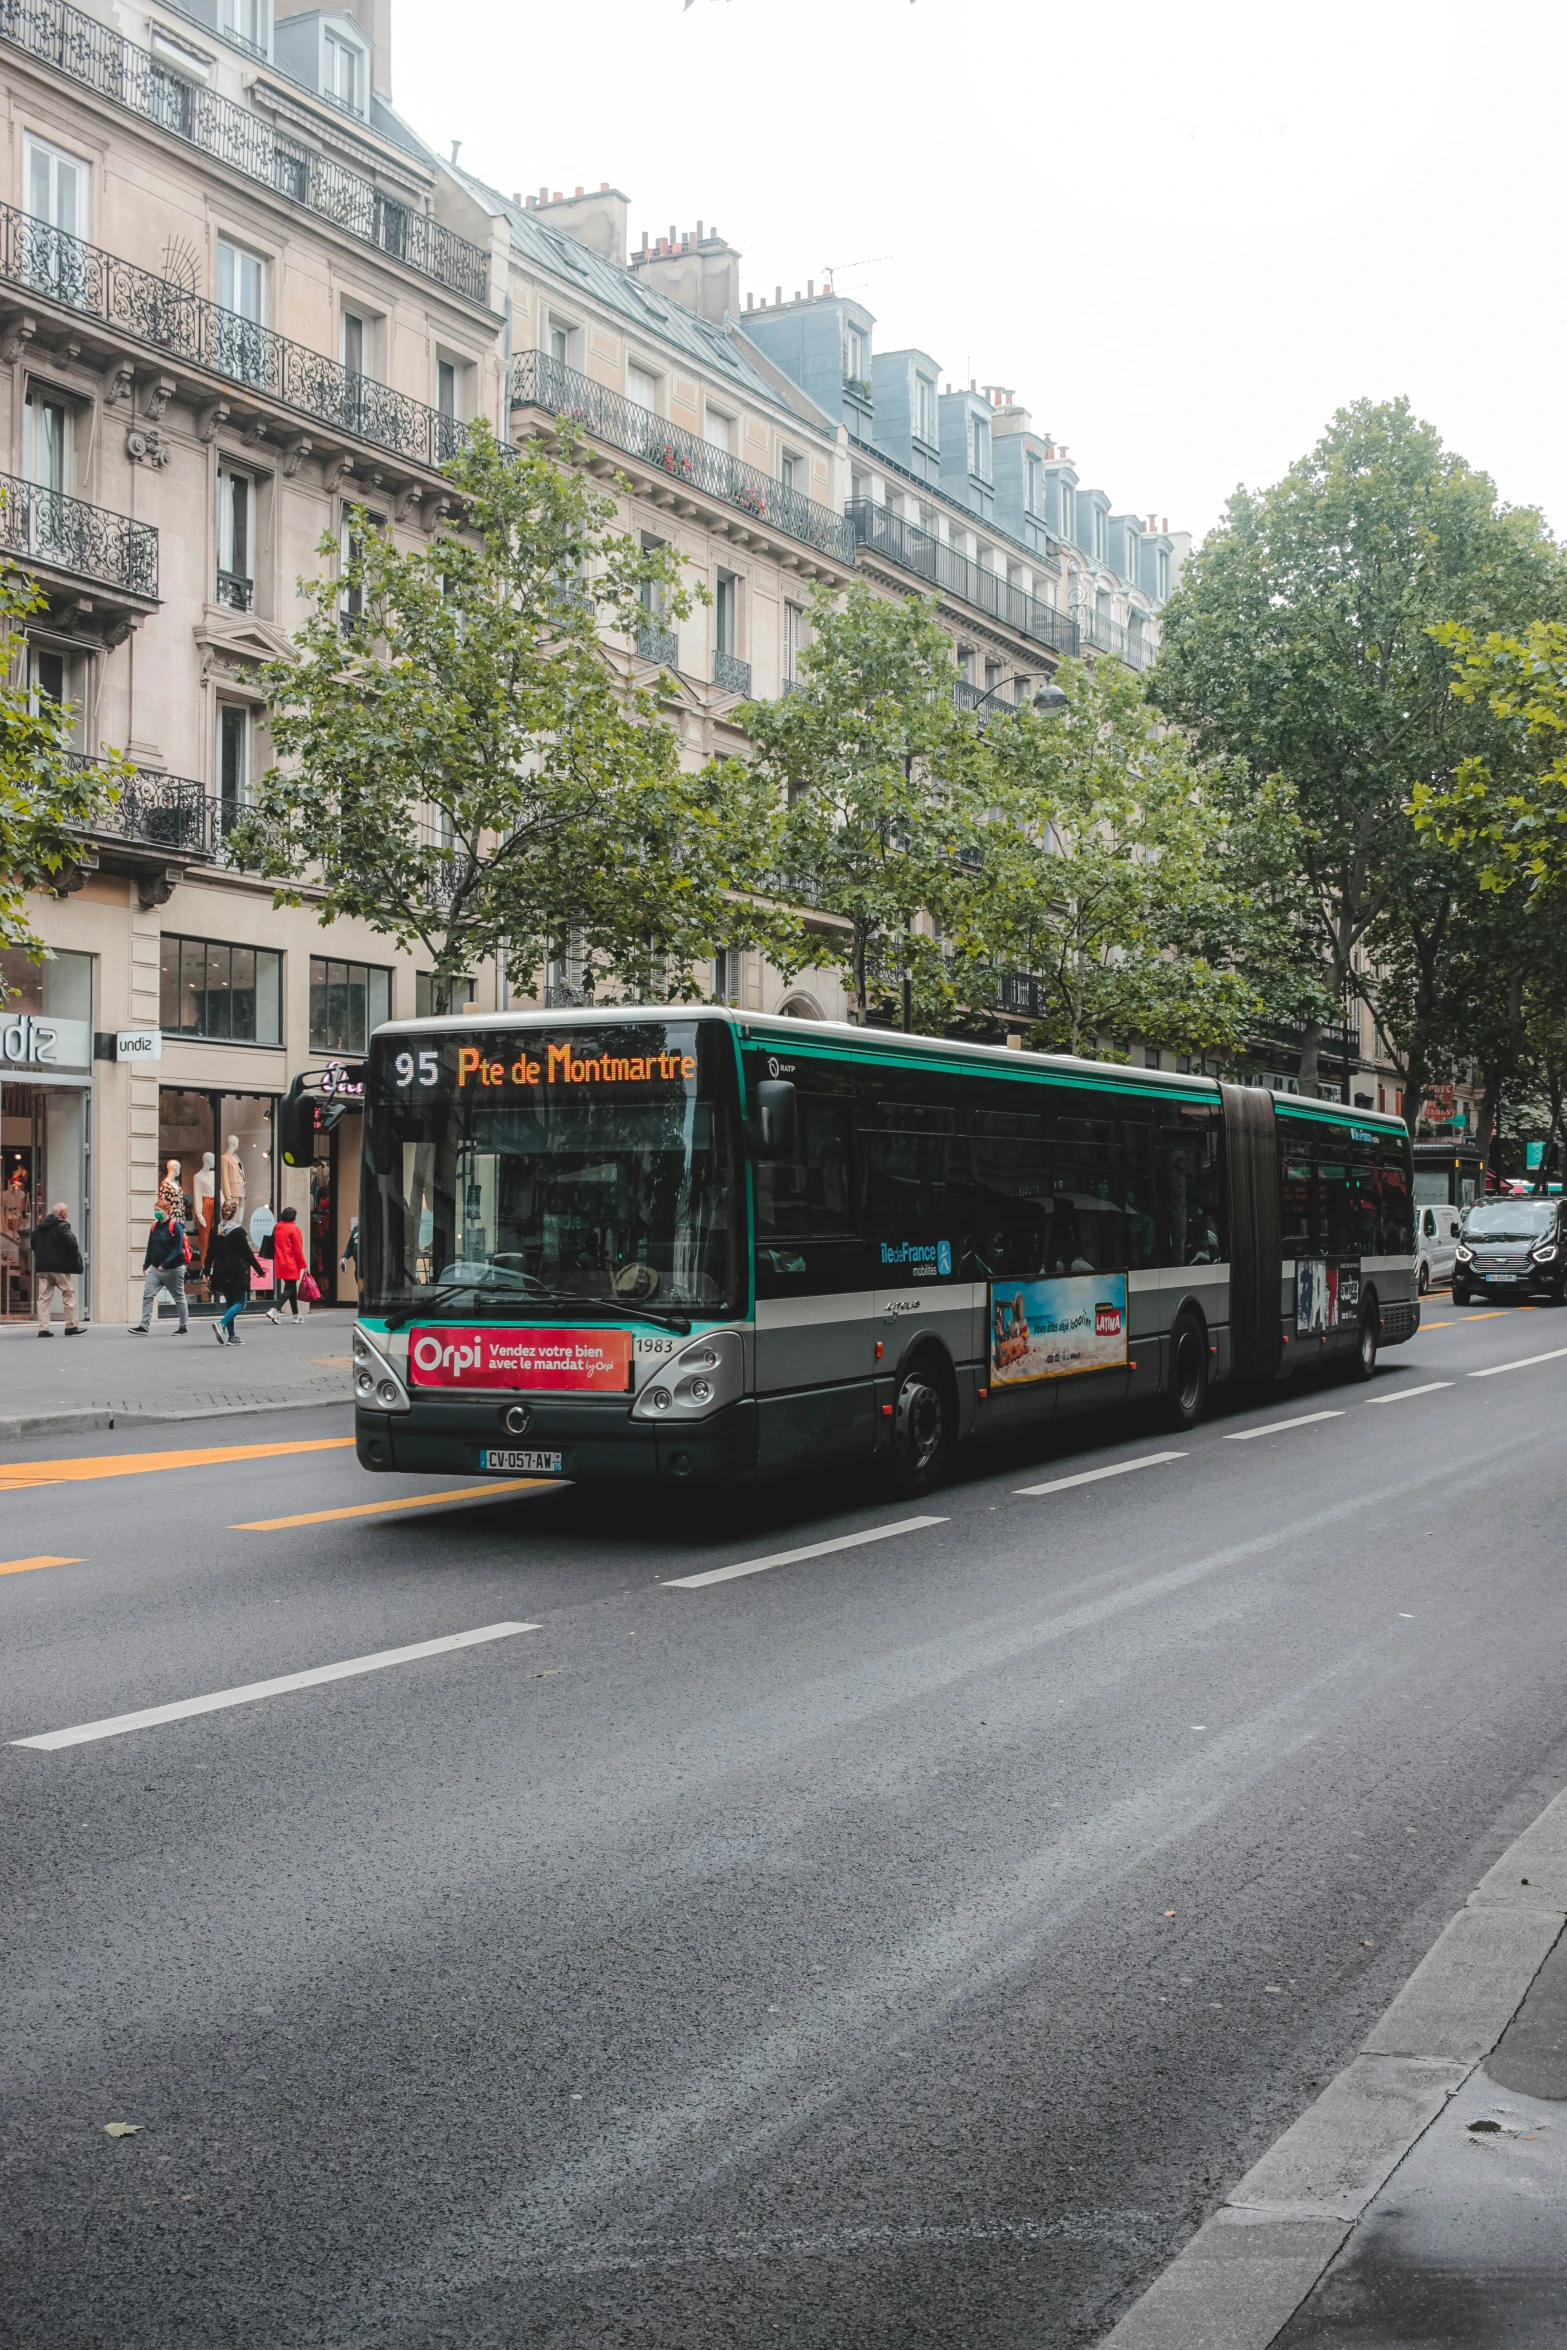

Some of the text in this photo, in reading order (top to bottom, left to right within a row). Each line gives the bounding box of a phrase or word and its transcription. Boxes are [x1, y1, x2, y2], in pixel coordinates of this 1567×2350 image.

[0, 1014, 57, 1063] diz
[119, 1037, 152, 1052] undiz
[395, 1043, 696, 1087] 95 Pte de Montmartre
[780, 1064, 796, 1073] RATP
[913, 1262, 937, 1276] mobilités
[1096, 1314, 1120, 1332] LATINA
[489, 1343, 603, 1358] Vendez votre bien
[636, 1339, 673, 1354] 1983
[414, 1336, 481, 1377] Orpi
[489, 1359, 518, 1370] avec
[520, 1358, 532, 1370] le
[534, 1358, 584, 1371] mandat
[596, 1361, 614, 1371] Orpi
[489, 1452, 552, 1469] CV-057-AW
[554, 1462, 562, 1470] 75
